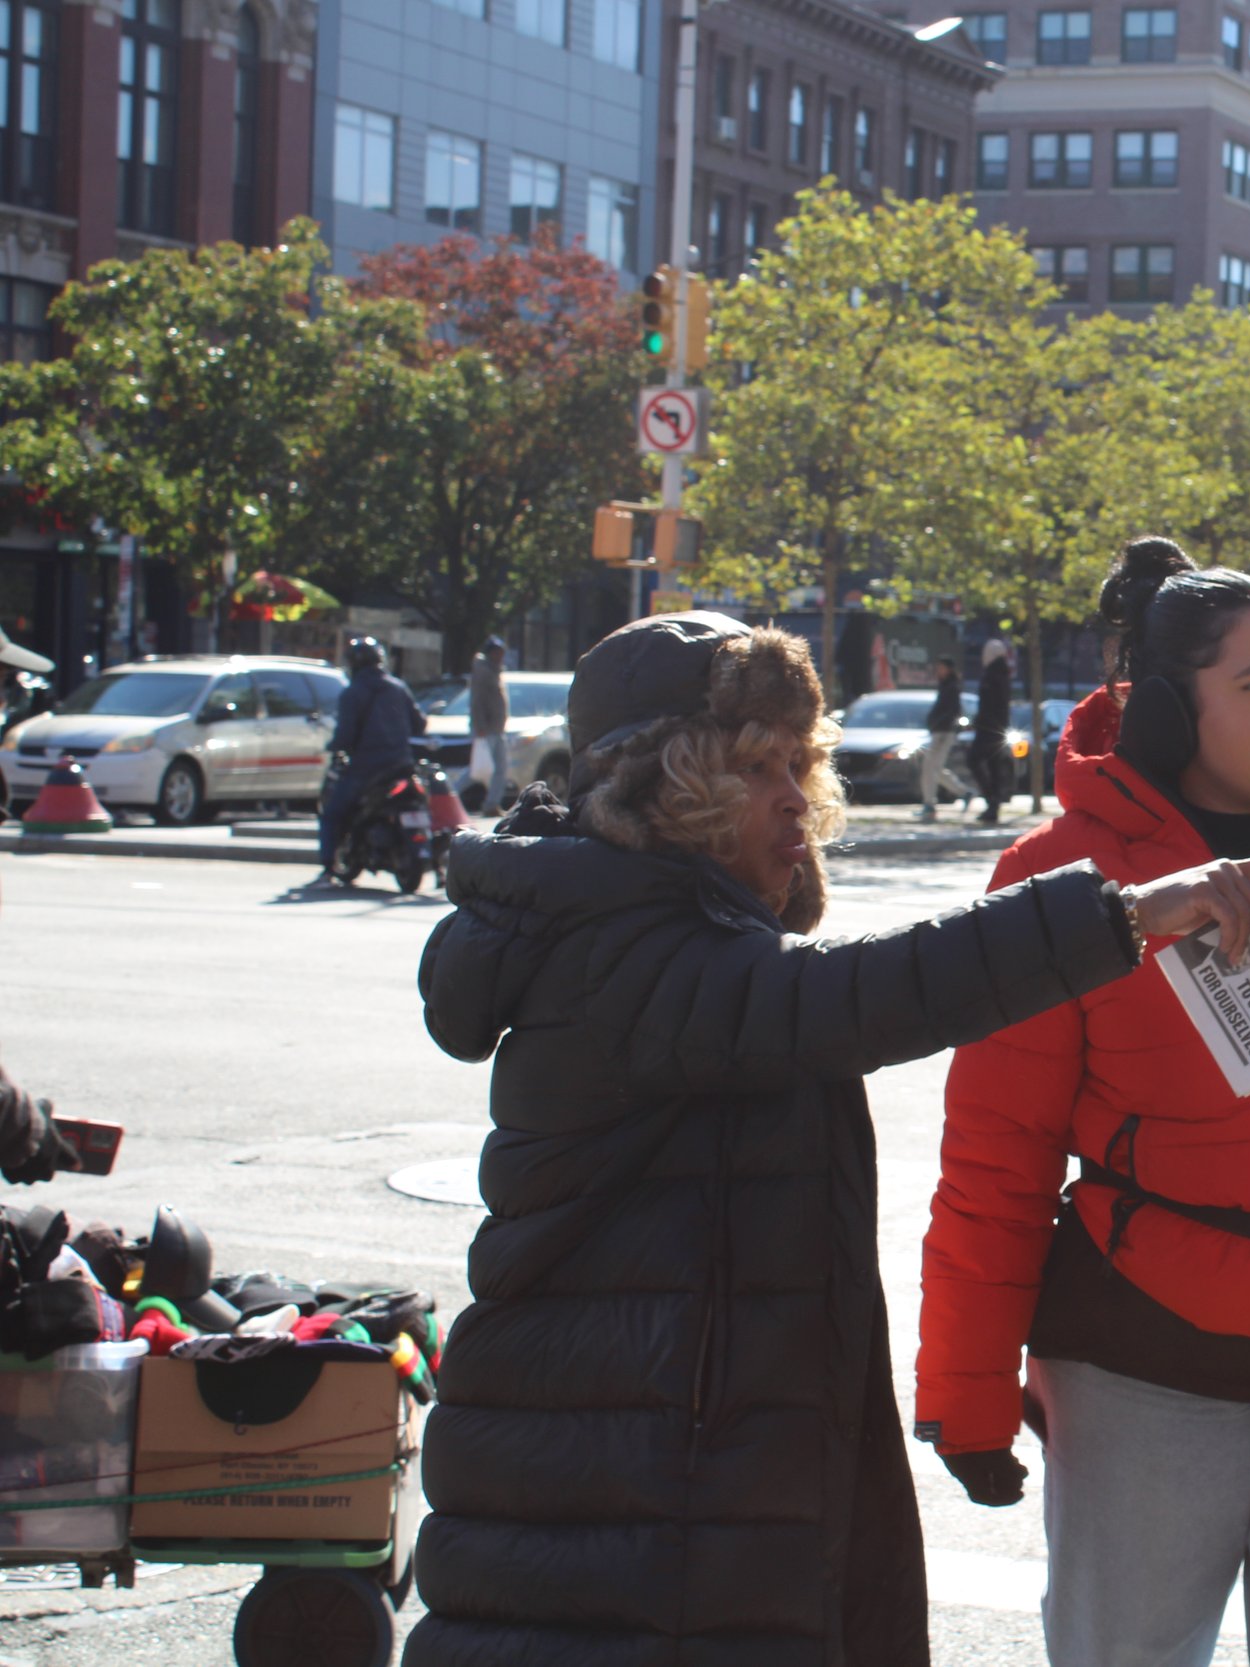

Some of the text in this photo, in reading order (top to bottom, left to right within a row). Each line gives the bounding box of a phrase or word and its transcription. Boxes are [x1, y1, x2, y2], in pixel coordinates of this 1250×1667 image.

[1198, 965, 1221, 993] FOR
[183, 1494, 352, 1508] PLEASE RETURN WHEN EMPTY
